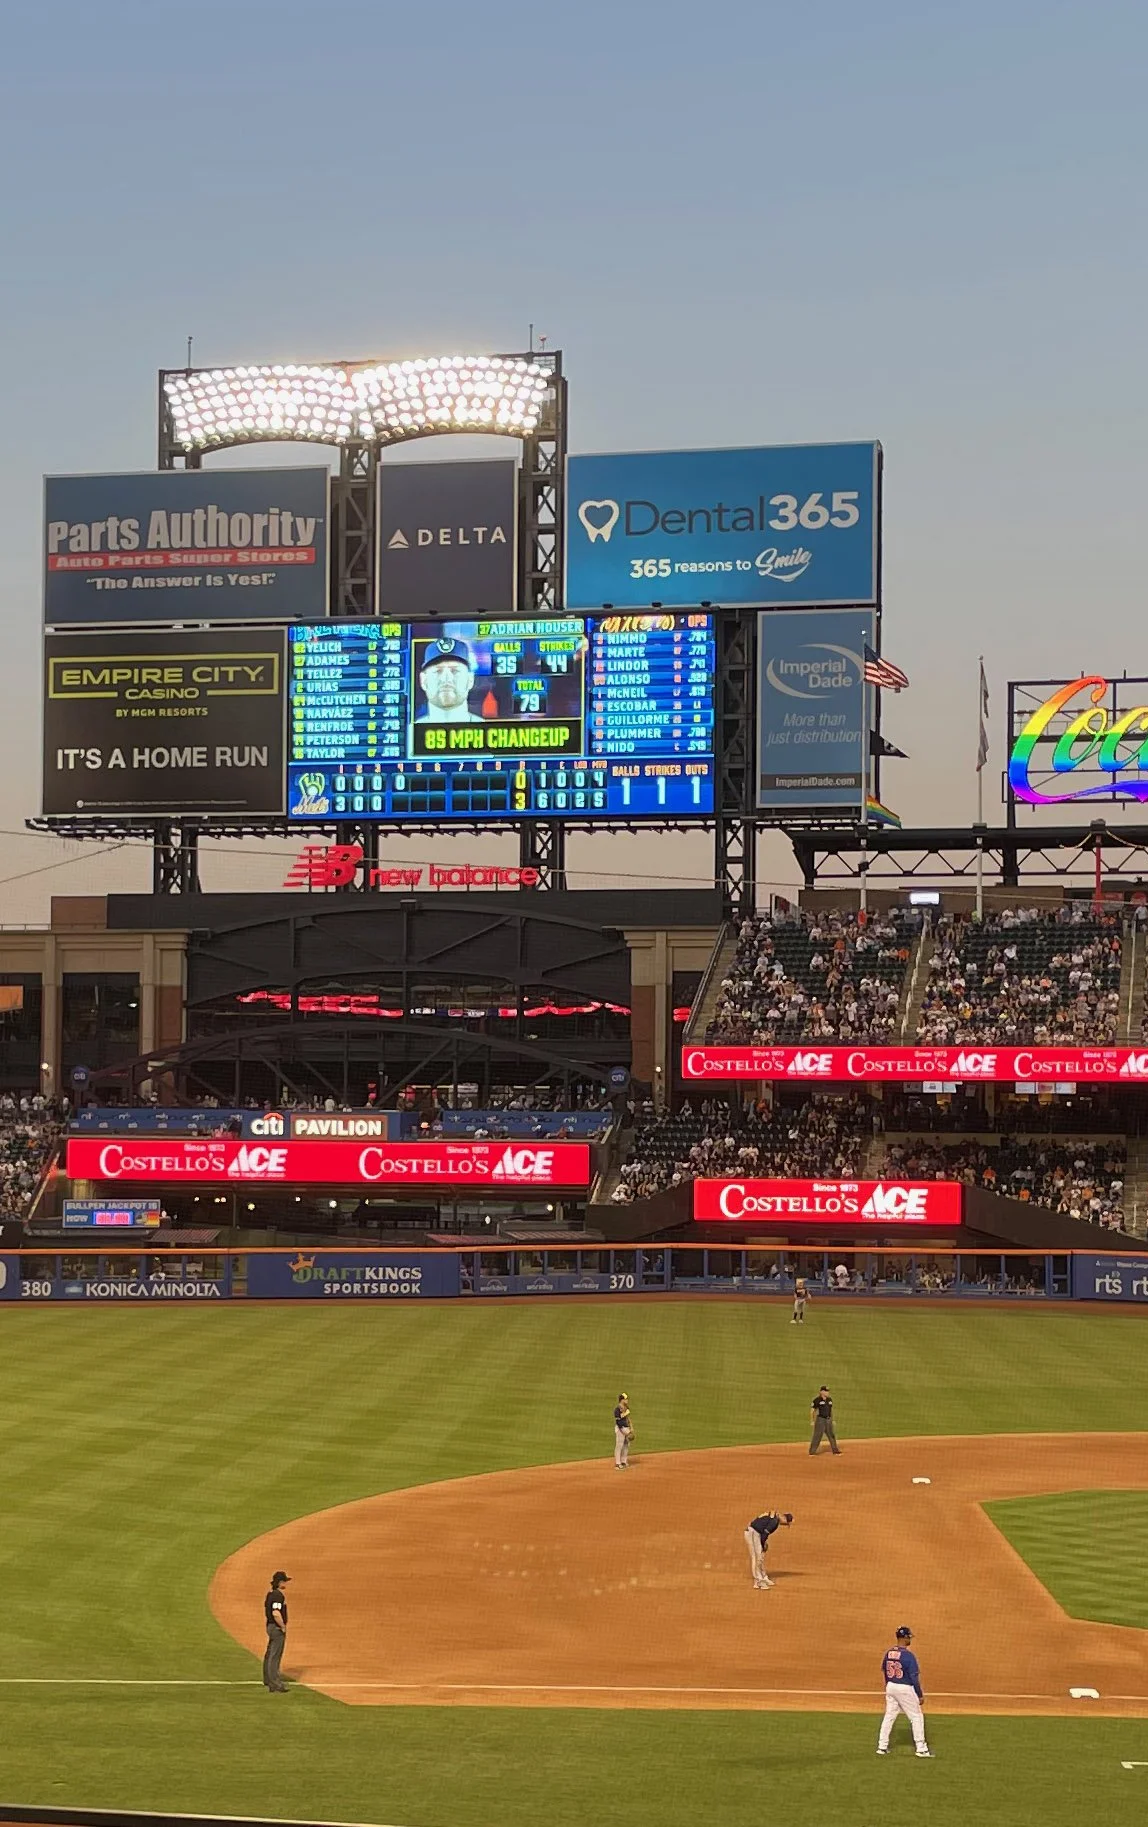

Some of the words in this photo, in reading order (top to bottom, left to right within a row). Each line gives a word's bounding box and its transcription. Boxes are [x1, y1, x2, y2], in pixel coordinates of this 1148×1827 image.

[624, 491, 860, 537] Dental365
[49, 516, 140, 553] Parts
[147, 505, 316, 549] Authority
[417, 526, 507, 546] DELTA
[56, 556, 103, 567] Auto
[109, 555, 164, 566] Parts
[169, 552, 232, 564] Super
[237, 551, 308, 562] Stores
[629, 558, 672, 579] 365
[674, 560, 733, 573] reasons
[736, 559, 752, 571] to
[754, 547, 812, 583] Smile
[132, 574, 202, 588] Answer
[490, 623, 535, 634] ADRIAN
[536, 622, 583, 634] HOUSER
[607, 633, 648, 644] NIMMO
[306, 641, 342, 653] YELICH
[494, 642, 522, 653] BALLS
[539, 641, 575, 652] STRIKES
[607, 647, 646, 658] MARTE
[306, 655, 350, 666] ADAMES
[496, 656, 517, 674] 35
[546, 655, 568, 673] 44
[607, 661, 649, 671] LINDOR
[779, 658, 847, 677] Imperial
[61, 667, 184, 686] EMPIRE
[192, 666, 262, 683] CITY
[306, 668, 343, 679] TELLEZ
[607, 674, 651, 685] ALONSO
[517, 680, 544, 691] TOTAL
[808, 674, 853, 689] Dade
[125, 687, 200, 700] CASINO
[306, 694, 366, 705] McCUTCHEN
[607, 688, 648, 699] McNEIL
[520, 694, 540, 712] 79
[607, 701, 657, 712] ESCOBAR
[115, 708, 129, 718] BY
[131, 708, 156, 717] MGM
[159, 707, 209, 717] RESORTS
[607, 714, 670, 725] GUILLORME
[783, 712, 815, 726] More
[819, 713, 847, 726] than
[306, 721, 354, 732] RENFROE
[607, 728, 661, 739] PLUMMER
[306, 734, 360, 745] PETERSON
[450, 729, 484, 749] MPH
[487, 727, 570, 748] CHANGEUP
[766, 731, 790, 747] just
[794, 729, 862, 744] distribution
[306, 747, 345, 759] TAYLOR
[607, 742, 635, 753] NIDO
[56, 748, 102, 770] IT’S
[108, 748, 126, 769] A
[133, 747, 208, 769] HOME
[215, 746, 268, 767] RUN
[612, 765, 640, 777] BALLS
[645, 765, 681, 776] STRIKES
[685, 764, 708, 775] OUTS
[335, 775, 345, 791] 0
[354, 775, 364, 791] 0
[372, 775, 382, 790] 0
[395, 774, 405, 790] 0
[515, 771, 526, 790] 0
[541, 772, 547, 788] 1
[557, 772, 567, 788] 0
[575, 771, 585, 788] 0
[595, 771, 604, 787] 4
[775, 777, 856, 789] ImperialDade.com
[622, 778, 630, 805] 1
[657, 777, 666, 804] 1
[691, 776, 700, 804] 1
[335, 796, 345, 811] 3
[354, 795, 364, 811] 0
[372, 795, 382, 811] 0
[515, 792, 526, 811] 3
[538, 792, 548, 808] 6
[557, 792, 567, 808] 0
[575, 792, 585, 808] 2
[370, 867, 423, 886] new
[429, 864, 538, 887] balance
[787, 1050, 833, 1072] ACE
[949, 1050, 997, 1073] ACE
[251, 1114, 284, 1135] citi
[295, 1119, 382, 1136] PAVILION
[228, 1144, 288, 1172] ACE
[491, 1146, 554, 1174] ACE
[812, 1183, 837, 1192] Since
[861, 1183, 928, 1213] ACE
[292, 1266, 422, 1283] DRAFTKINGS
[21, 1282, 51, 1296] 380
[323, 1283, 421, 1294] SPORTSBOOK
[609, 1275, 634, 1289] 370
[1095, 1274, 1122, 1295] rts
[86, 1283, 148, 1297] KONICA
[151, 1283, 220, 1297] MINOLTA
